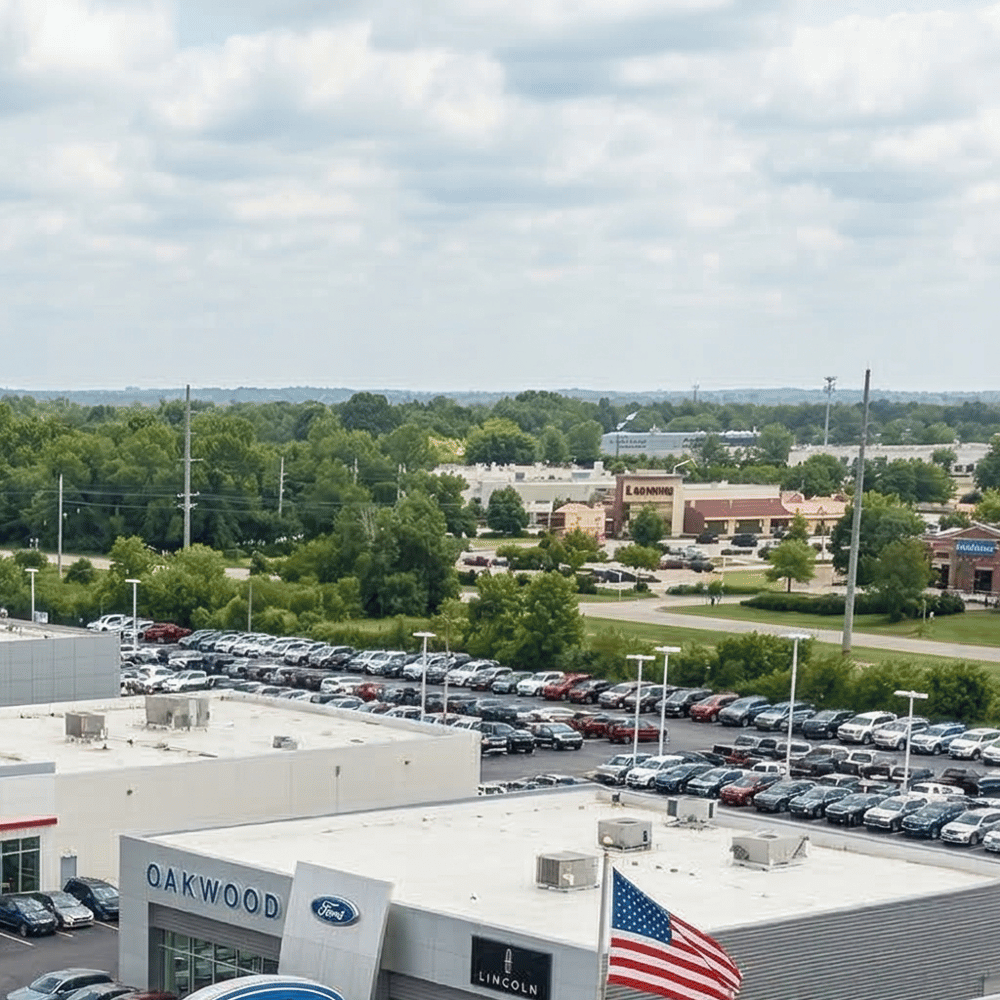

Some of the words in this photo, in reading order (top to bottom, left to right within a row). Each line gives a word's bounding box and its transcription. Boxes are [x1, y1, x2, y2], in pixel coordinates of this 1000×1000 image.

[147, 863, 280, 919] OAKWOOD
[317, 900, 346, 921] Ford
[479, 971, 538, 996] LINCOLN
